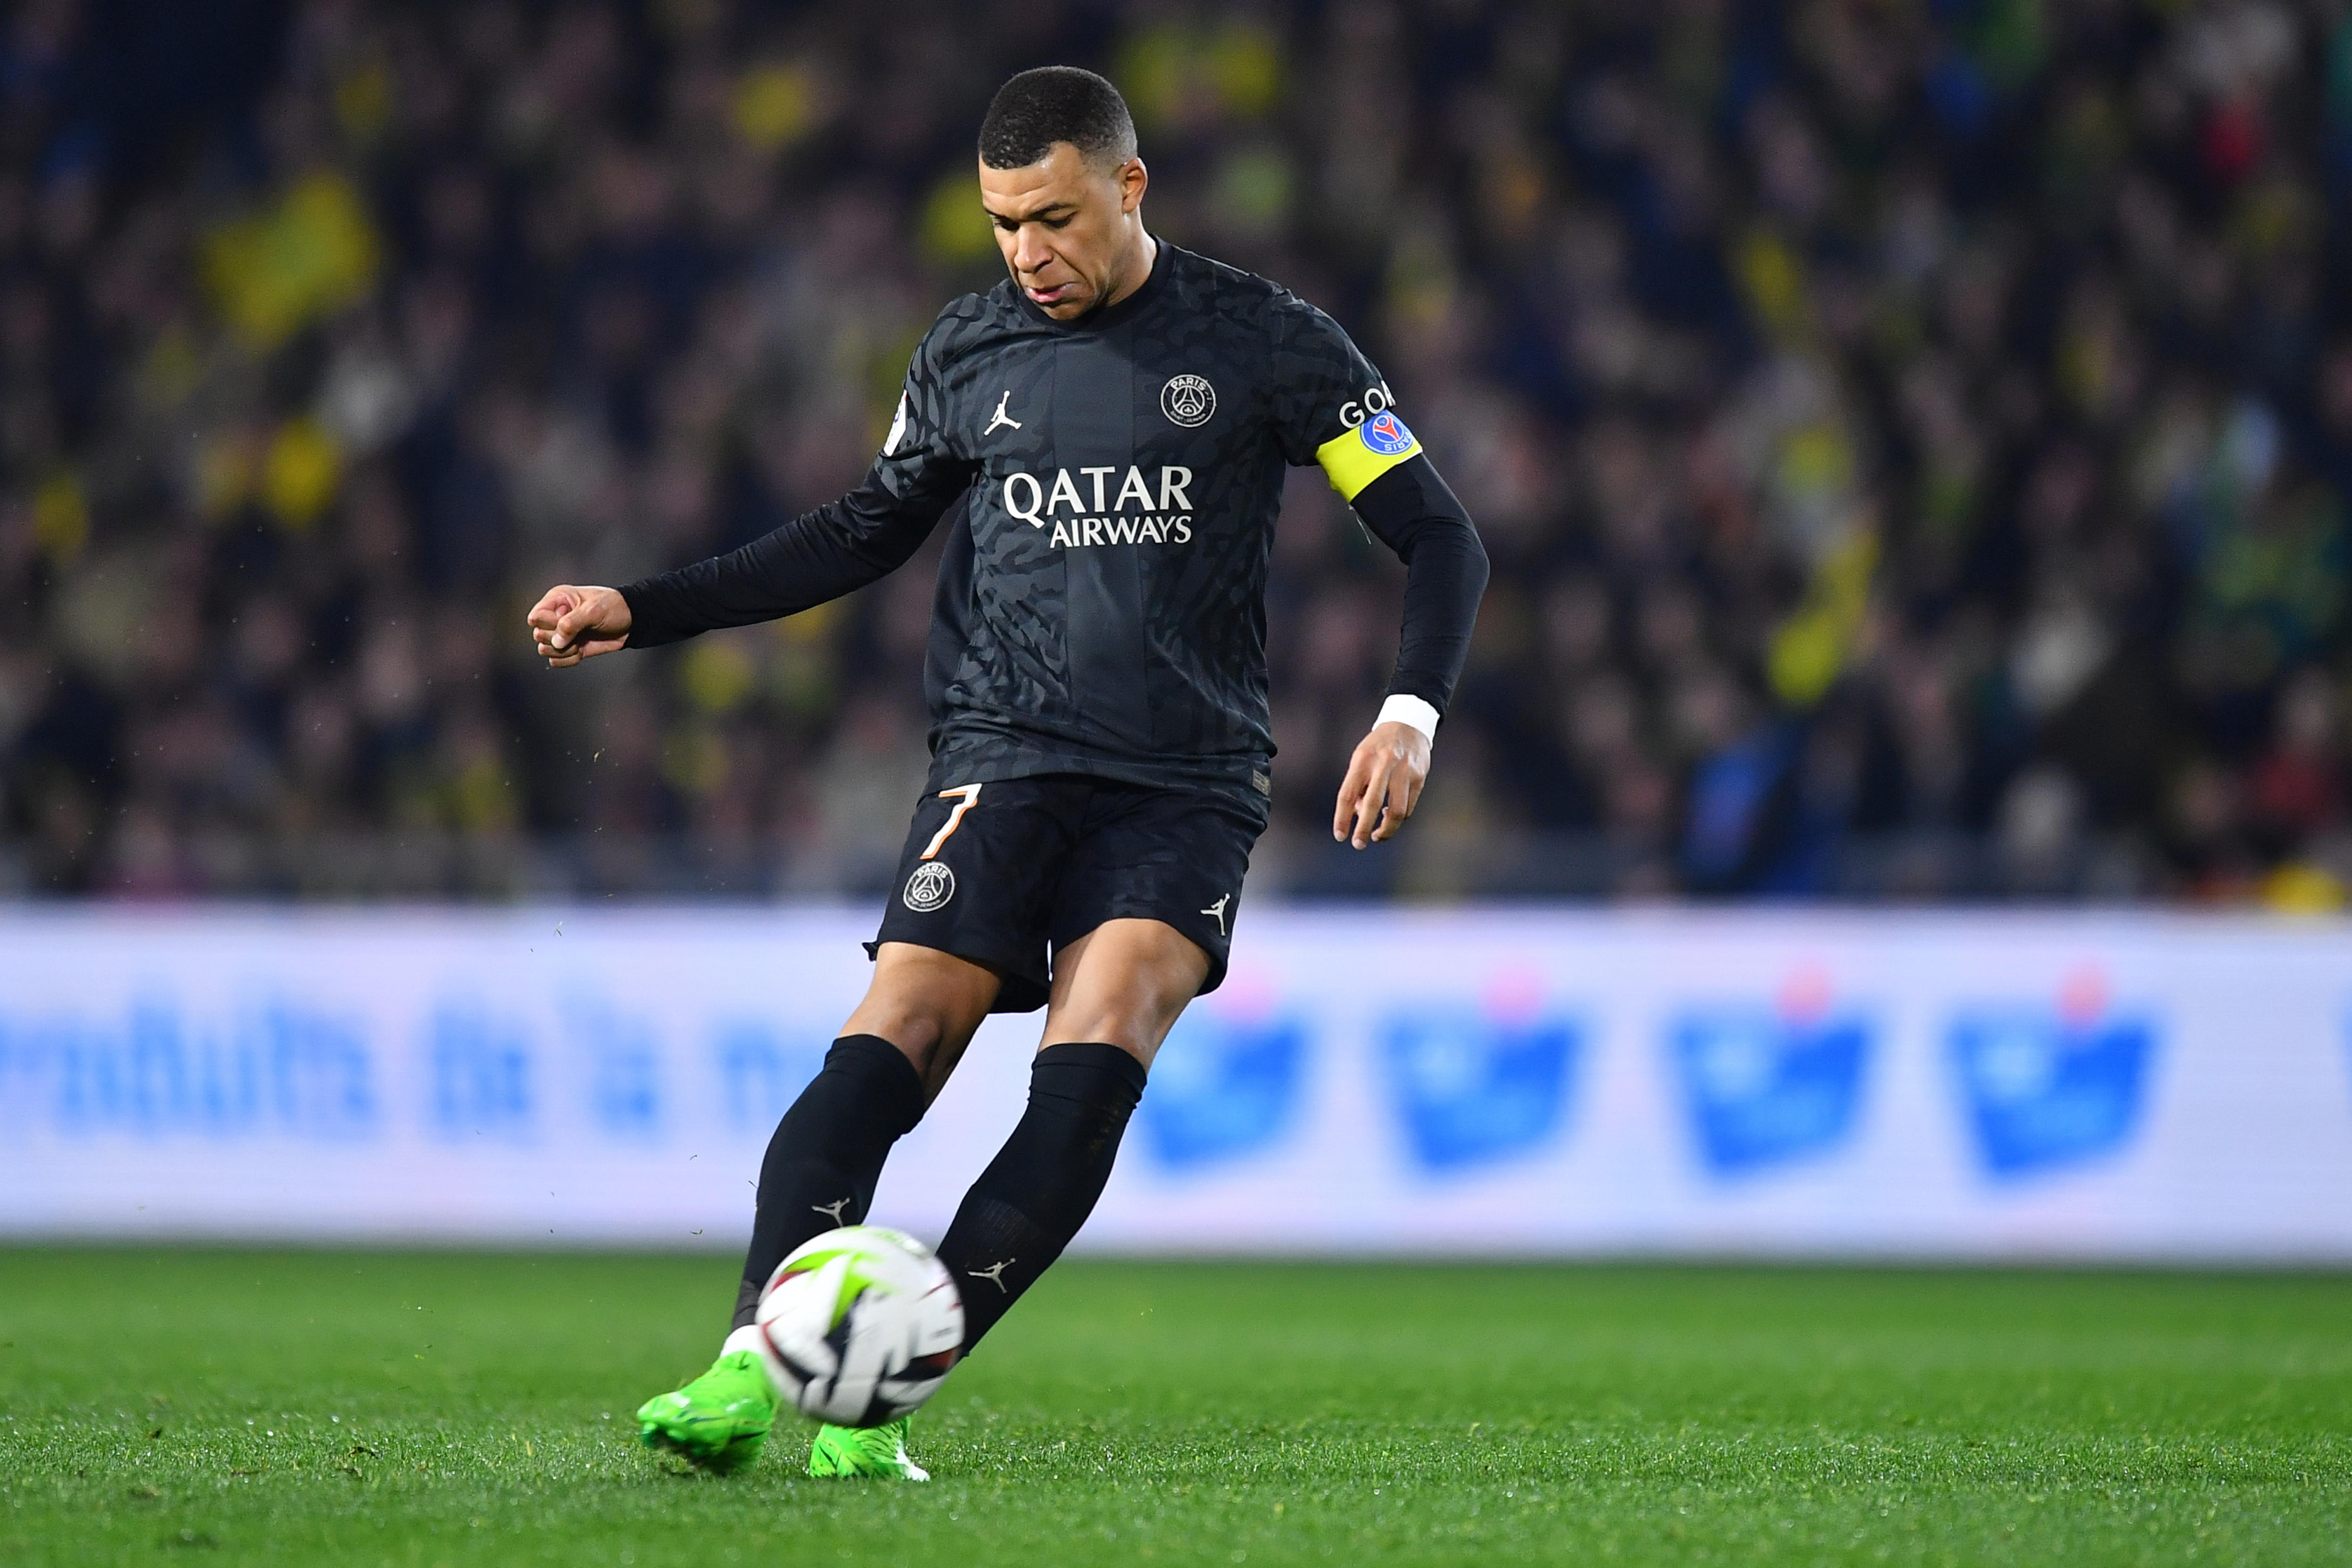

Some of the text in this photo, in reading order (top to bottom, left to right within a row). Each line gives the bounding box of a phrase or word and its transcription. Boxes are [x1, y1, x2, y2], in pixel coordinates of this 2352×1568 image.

[1170, 377, 1206, 390] PARIS
[1384, 431, 1412, 451] PARIS
[1003, 465, 1194, 529] QATAR
[1050, 516, 1192, 549] AIRWAYS
[920, 783, 983, 860] 7
[917, 866, 948, 879] PARIS
